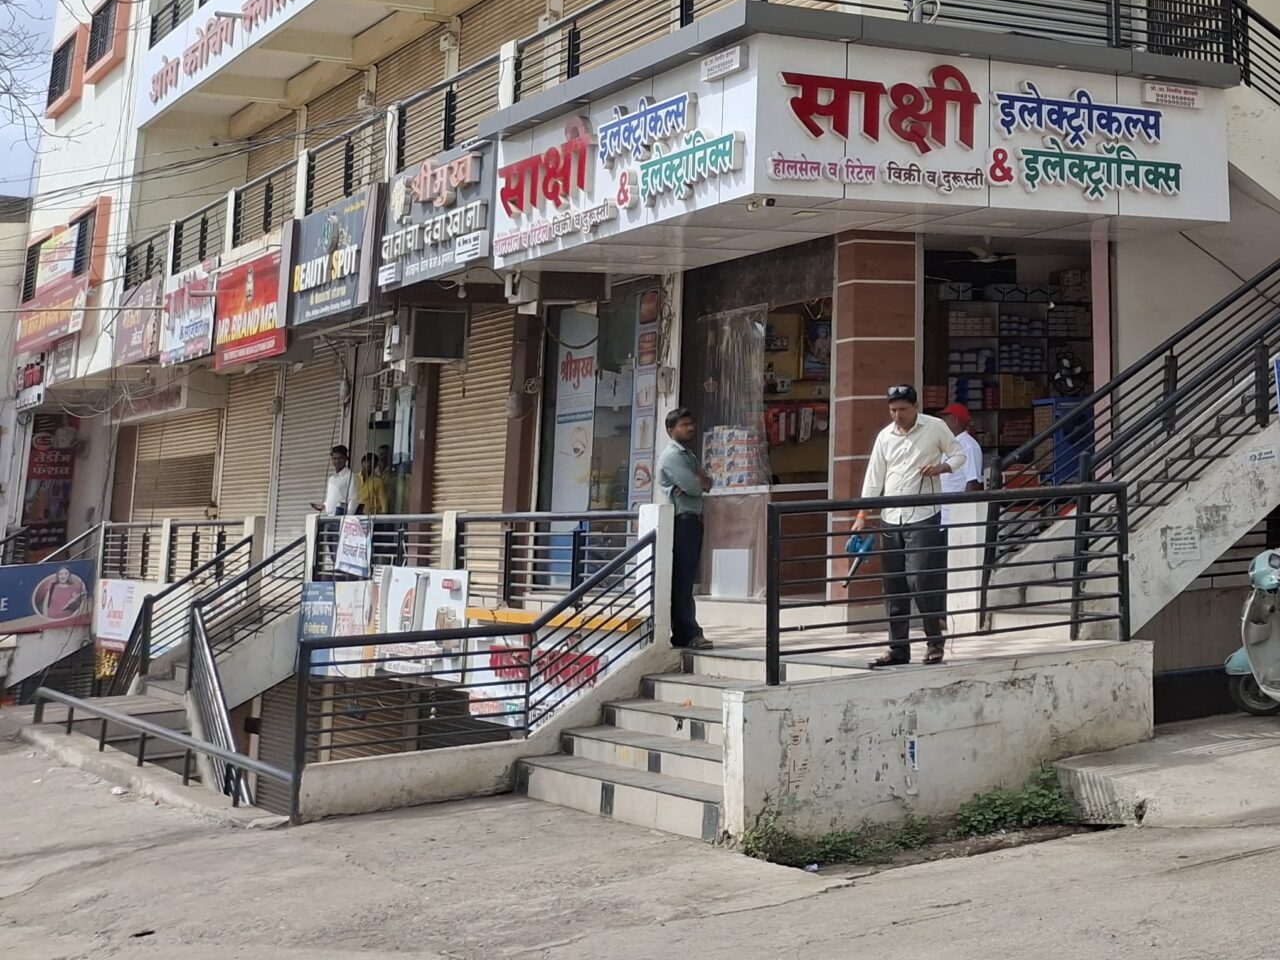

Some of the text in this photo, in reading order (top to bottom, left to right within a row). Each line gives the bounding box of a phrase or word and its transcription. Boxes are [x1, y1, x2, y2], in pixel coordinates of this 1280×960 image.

[150, 54, 180, 105] ओम
[780, 63, 982, 156] साक्षी
[498, 114, 592, 218] साक्षी
[616, 132, 735, 208] & इलेक्ट्रॉनिक्स
[772, 153, 822, 180] होलसेल
[827, 165, 838, 178] व
[845, 159, 876, 183] रिटेल
[886, 161, 920, 182] विक्री
[926, 170, 938, 185] व
[989, 138, 1182, 199] & इलेक्ट्रॉनिक्स
[424, 200, 481, 246] दवाखाना
[294, 253, 329, 293] BEAUTY
[332, 243, 358, 280] SPOT
[560, 350, 595, 390] श्रीमुख
